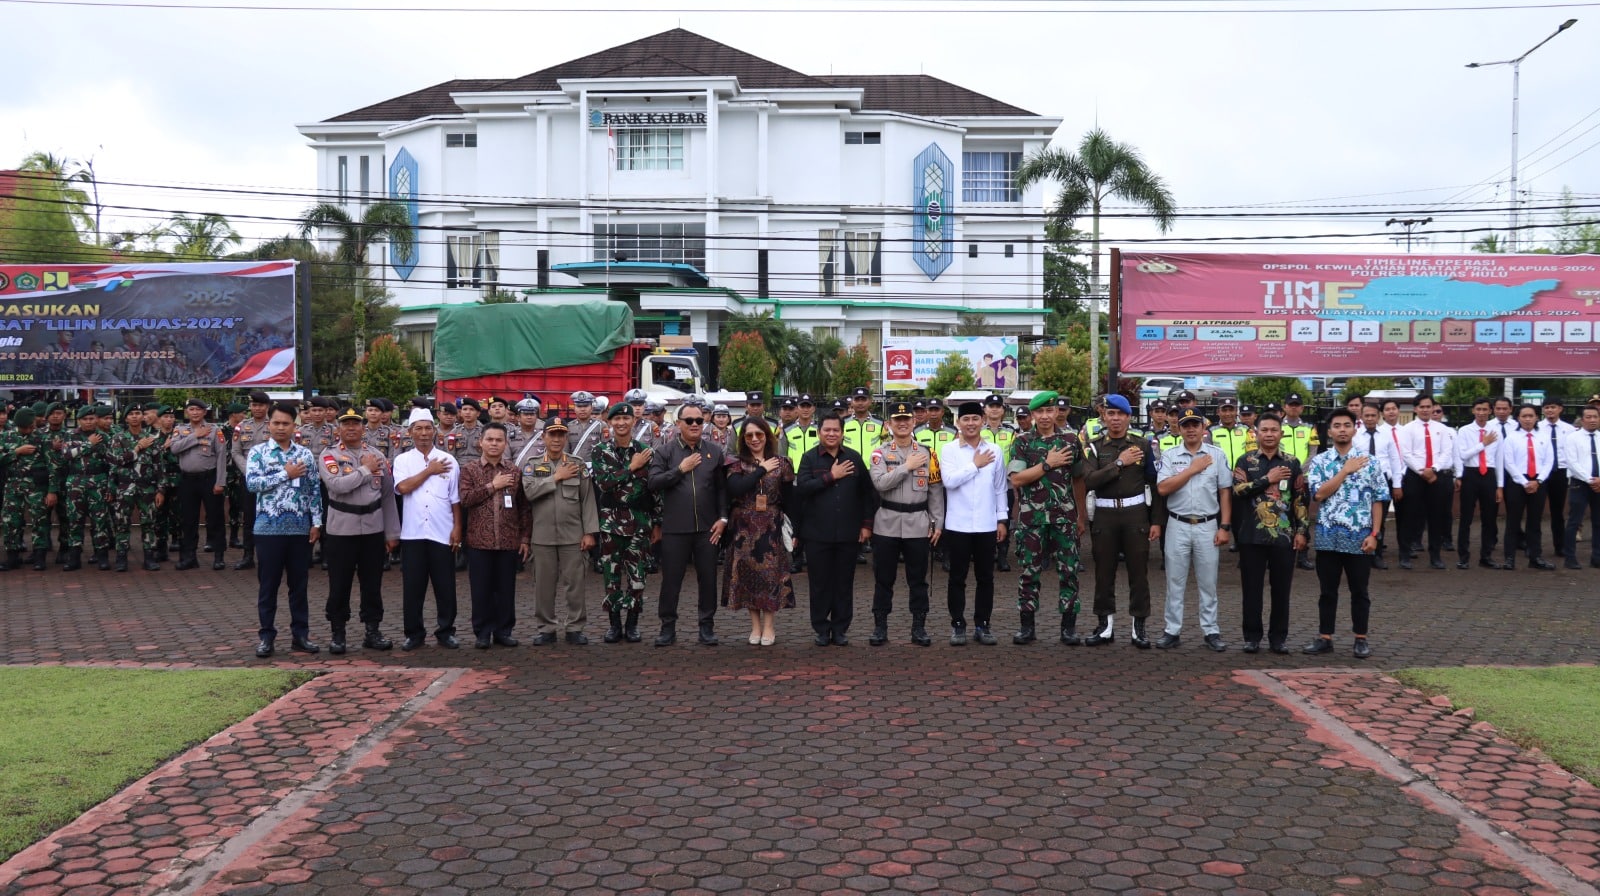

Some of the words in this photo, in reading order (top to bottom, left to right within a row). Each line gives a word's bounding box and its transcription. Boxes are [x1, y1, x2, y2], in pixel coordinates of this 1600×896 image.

[604, 112, 642, 124] BANK
[646, 112, 706, 124] KALBAR
[1364, 258, 1430, 266] TIMELINE
[186, 291, 234, 304] 2025
[19, 352, 49, 360] DAN
[52, 352, 100, 360] TAHUN
[103, 351, 140, 359] BARU
[143, 351, 175, 359] 2025
